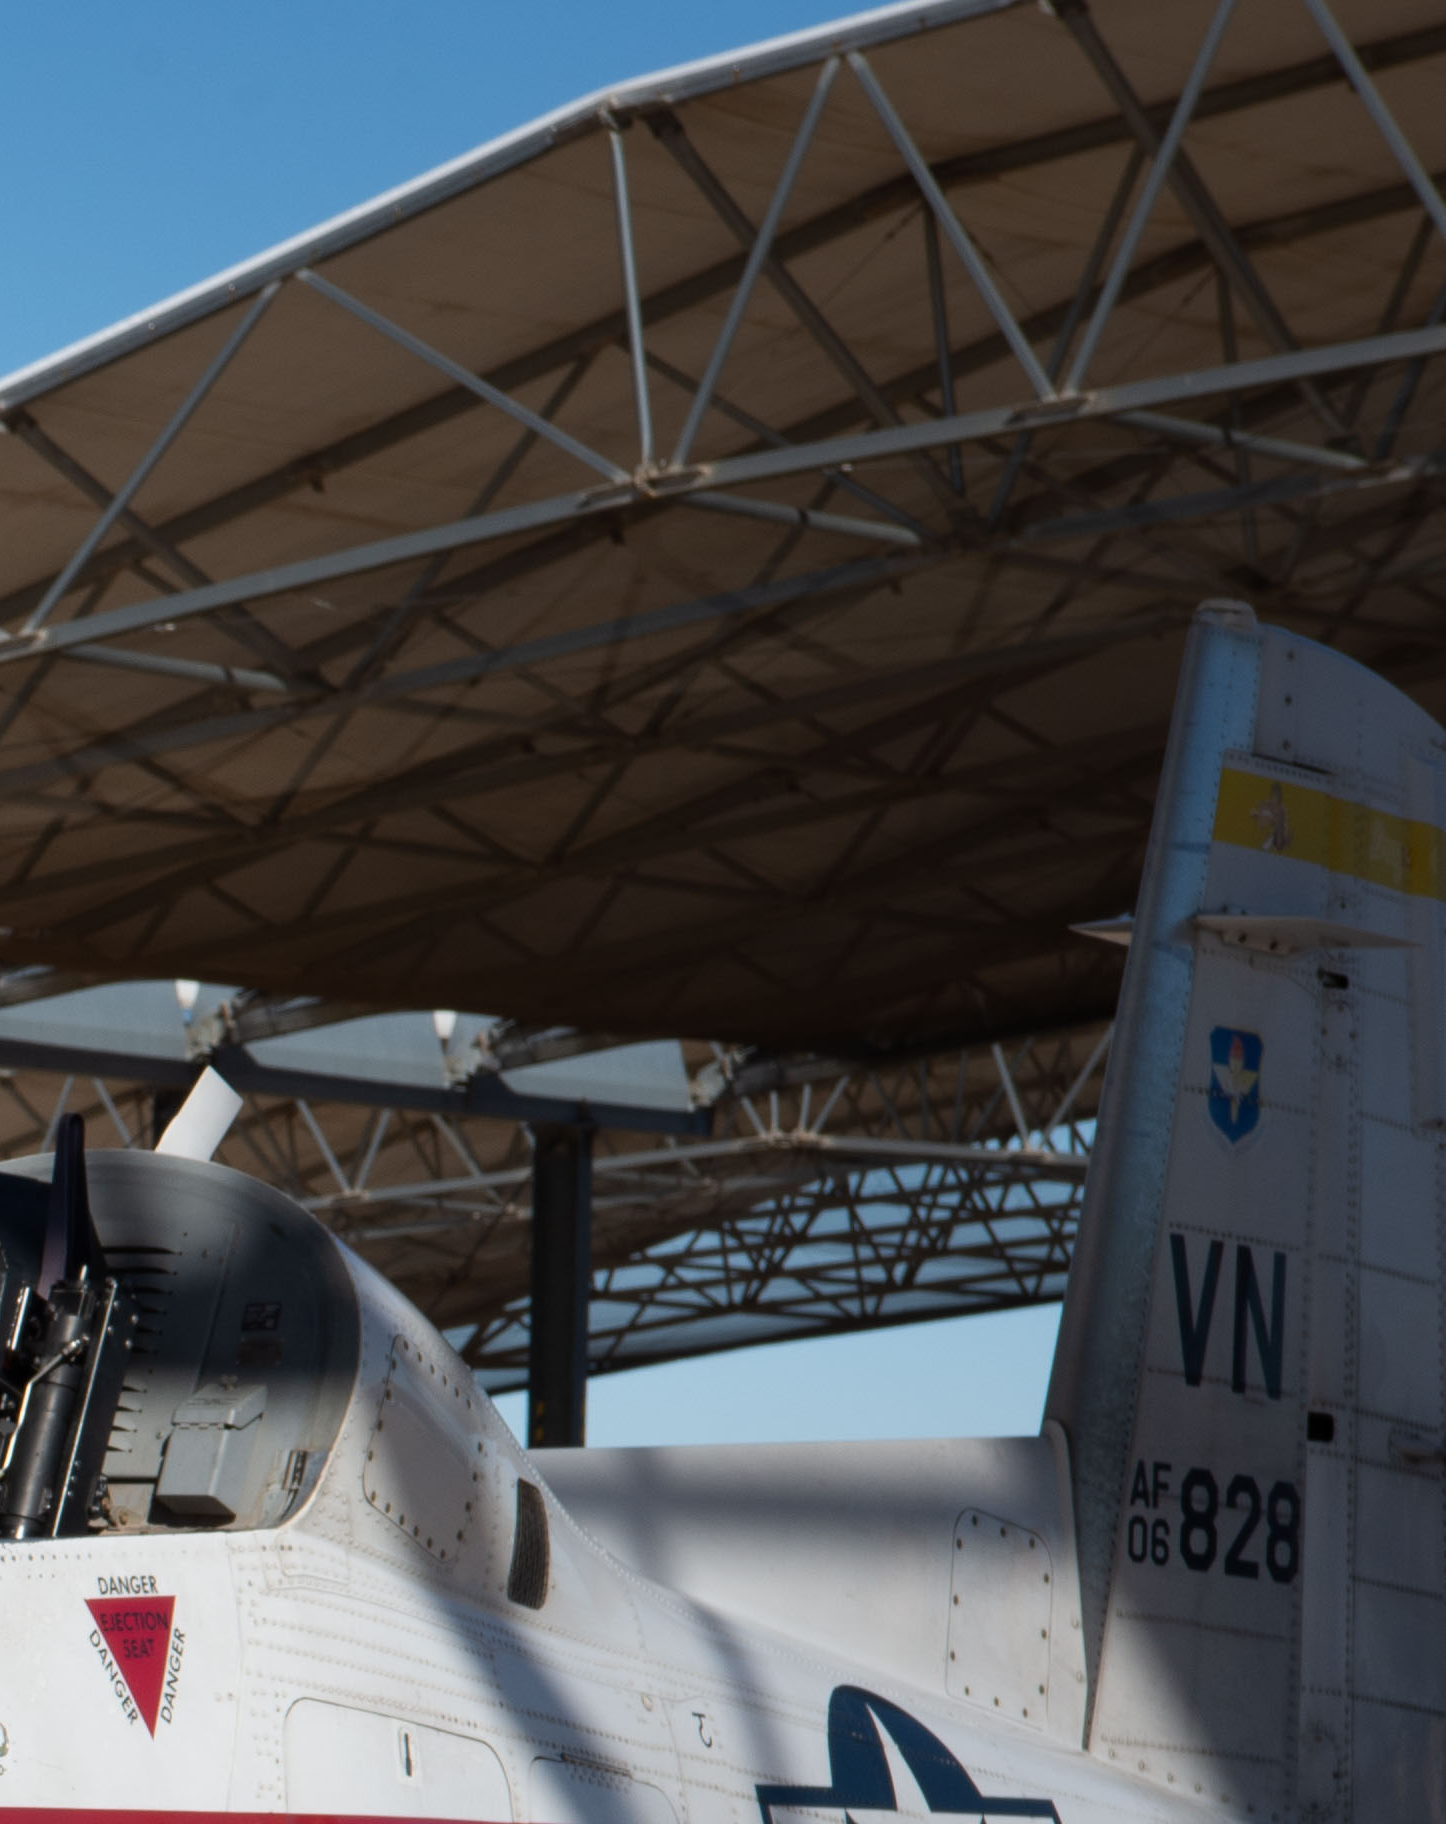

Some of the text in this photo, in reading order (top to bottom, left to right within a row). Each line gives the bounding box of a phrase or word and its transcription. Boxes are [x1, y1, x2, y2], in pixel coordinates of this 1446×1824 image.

[1169, 1232, 1287, 1400] VN
[1129, 1459, 1172, 1508] AF
[1127, 1515, 1170, 1567] 06
[1179, 1466, 1301, 1585] 828
[97, 1575, 158, 1595] DANGER
[100, 1611, 169, 1632] EJECTION
[123, 1638, 154, 1659] SEAT
[89, 1628, 139, 1725] DANGER
[160, 1627, 186, 1725] DANGER
